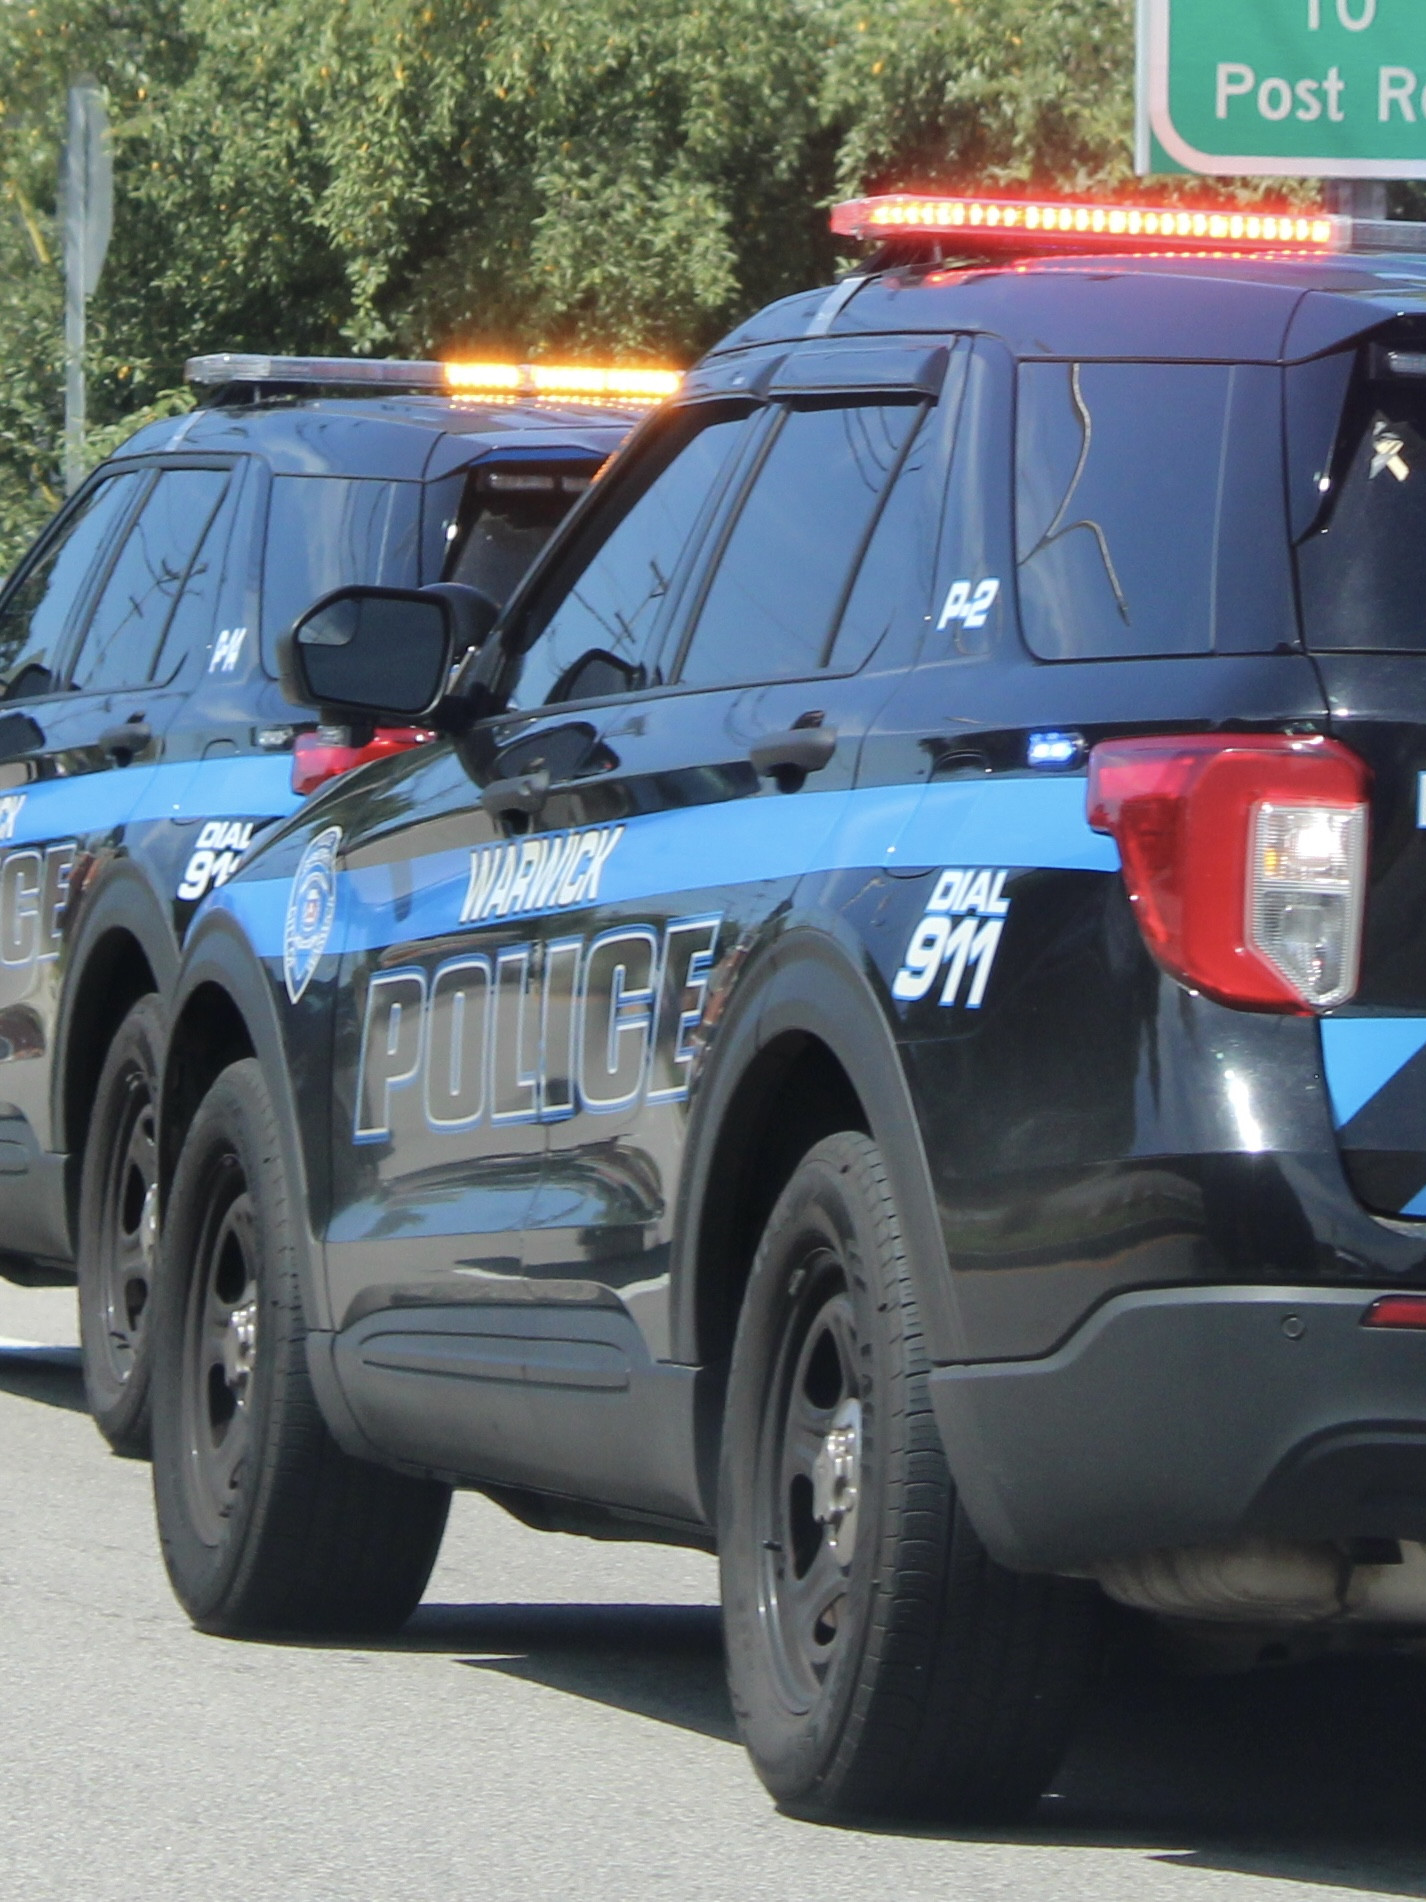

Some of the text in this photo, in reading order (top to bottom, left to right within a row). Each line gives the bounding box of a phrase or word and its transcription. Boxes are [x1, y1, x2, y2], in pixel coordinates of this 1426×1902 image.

[1215, 62, 1345, 122] Post
[936, 577, 1000, 632] P-2
[195, 820, 254, 850] DIAL
[459, 823, 627, 924] WARWICK
[924, 867, 1011, 917] DIAL
[891, 914, 1006, 1009] 911
[352, 910, 725, 1146] POLICE
